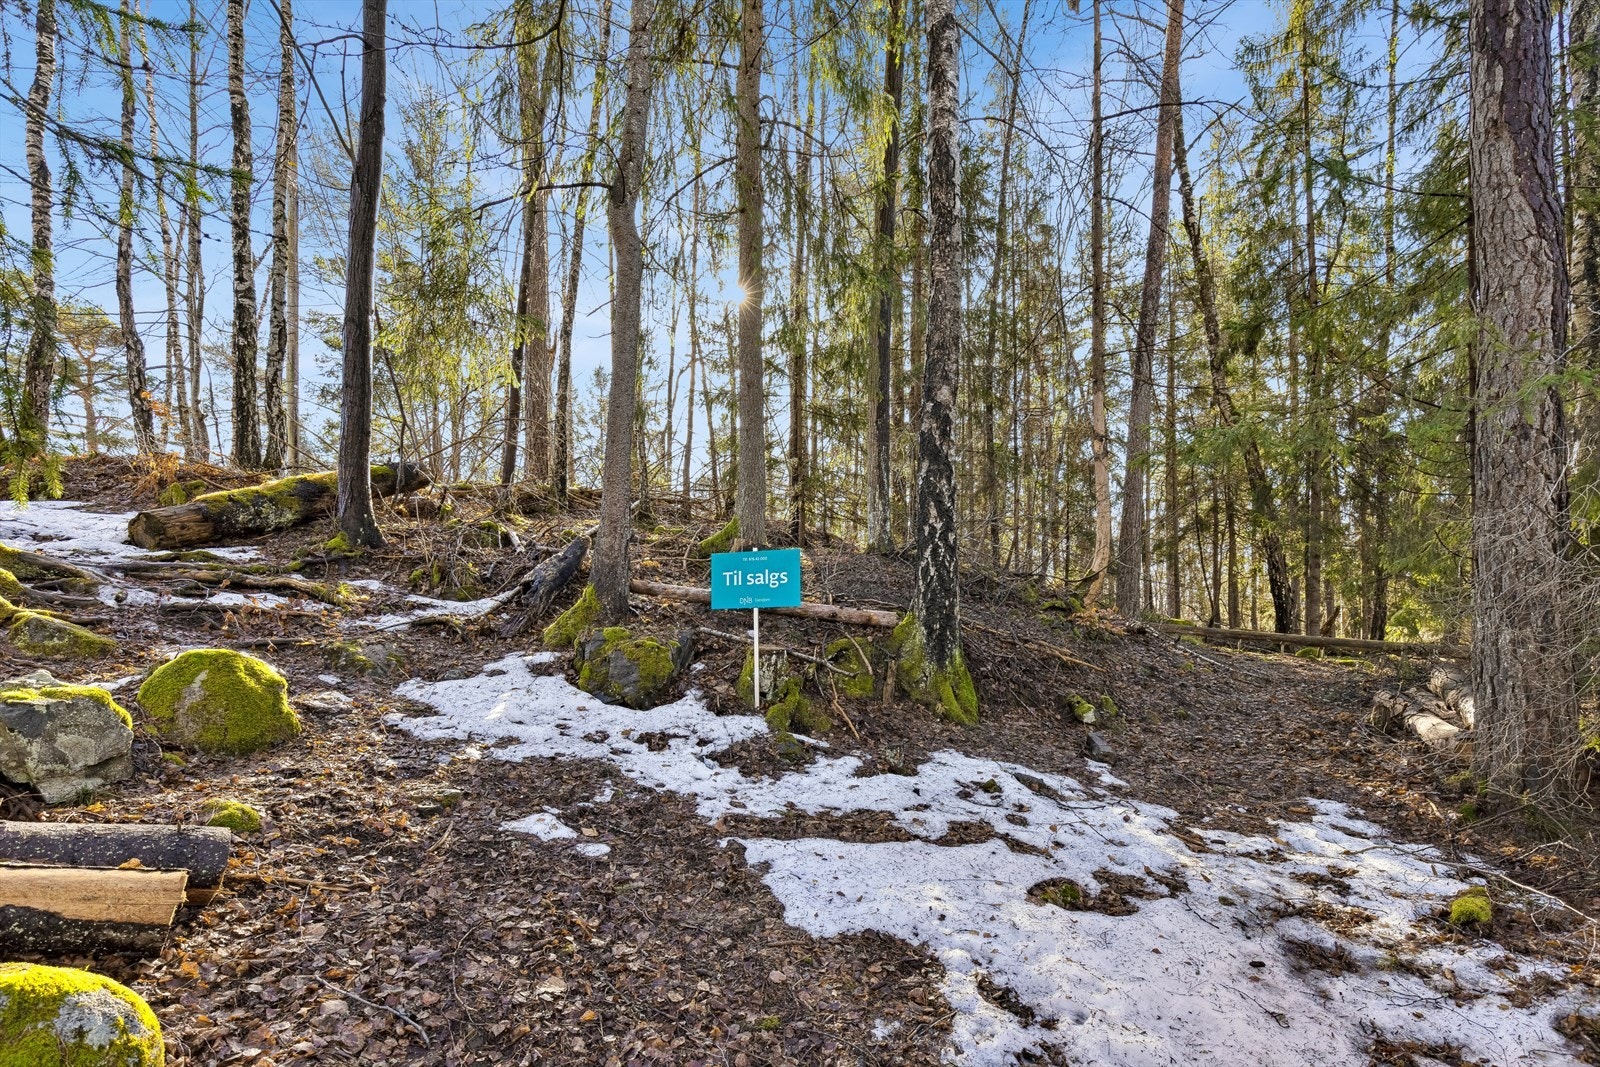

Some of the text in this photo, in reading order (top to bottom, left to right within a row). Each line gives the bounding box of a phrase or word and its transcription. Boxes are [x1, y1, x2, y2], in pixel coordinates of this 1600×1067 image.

[723, 569, 788, 588] Til salgs
[740, 596, 753, 605] DNB
